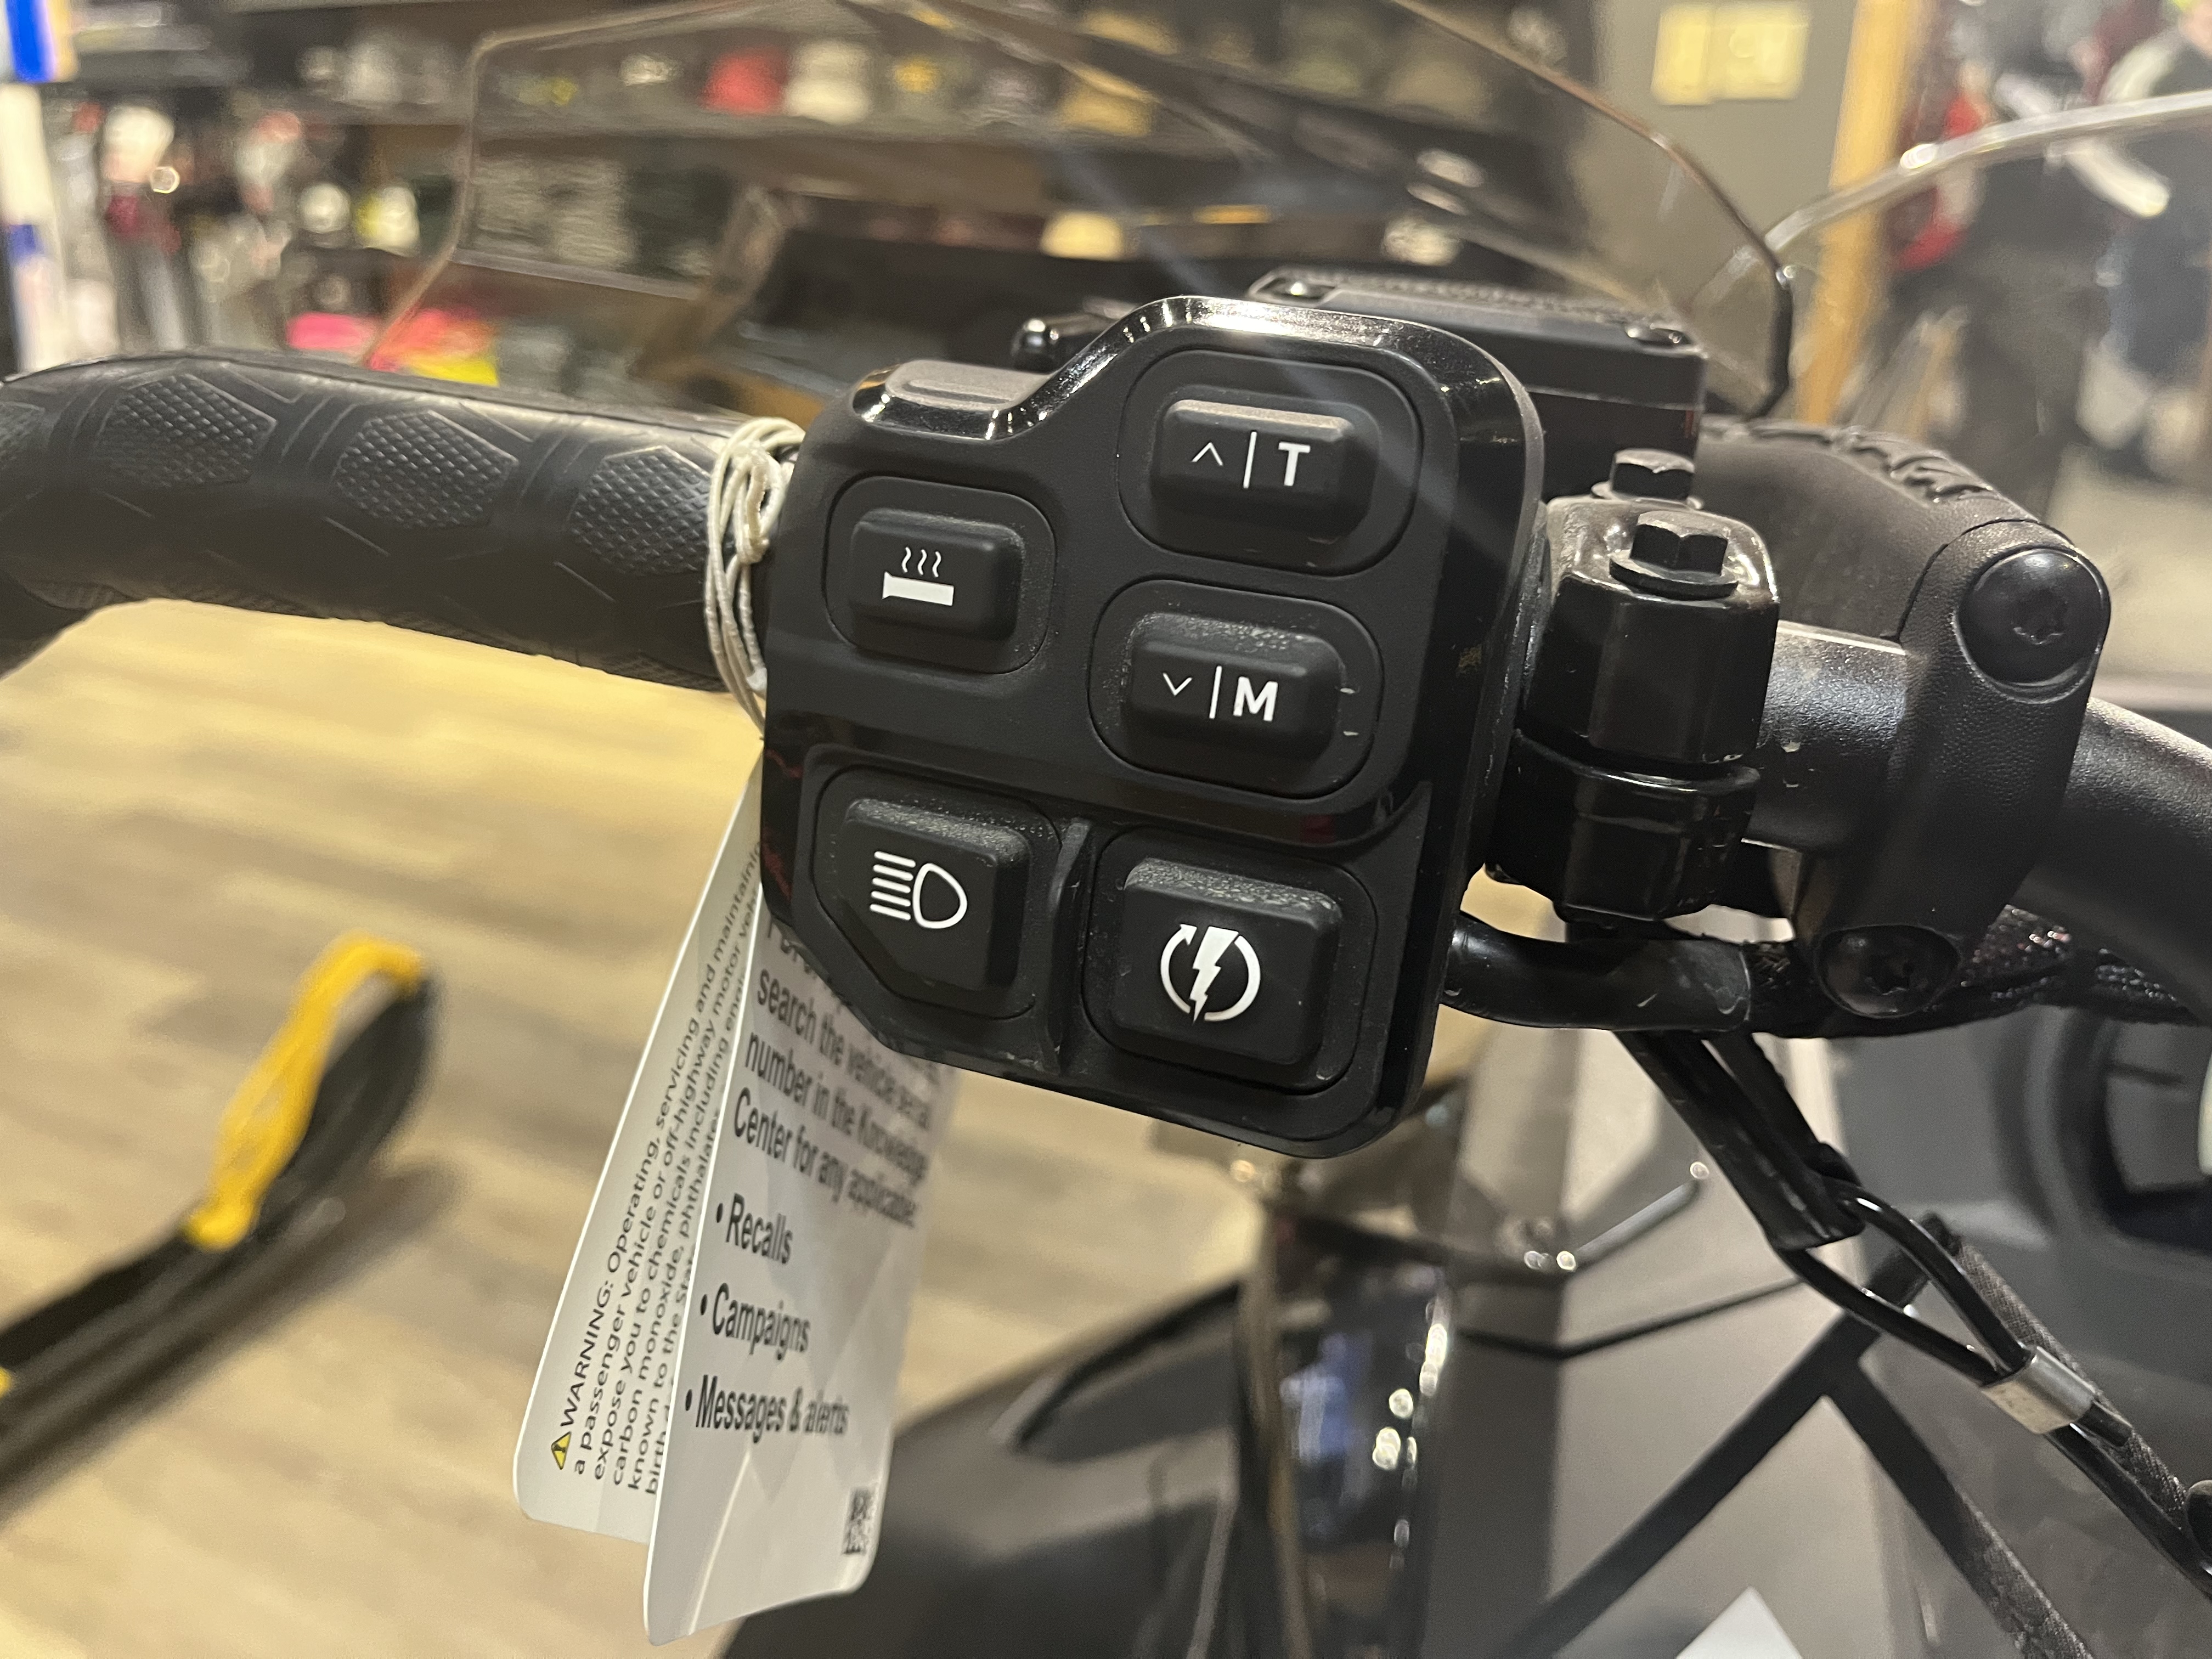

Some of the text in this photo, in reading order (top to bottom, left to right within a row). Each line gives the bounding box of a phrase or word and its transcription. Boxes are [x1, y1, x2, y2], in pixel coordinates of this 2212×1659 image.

[757, 968, 816, 1044] search
[745, 1032, 812, 1106] number
[812, 1073, 830, 1119] in
[735, 1087, 792, 1162] Center
[793, 1125, 819, 1176] for
[560, 1280, 613, 1426] WARNING:
[607, 1138, 660, 1273] Operating,
[656, 1018, 699, 1130] servicing
[696, 964, 715, 1014] and
[574, 1460, 585, 1475] a
[580, 1304, 625, 1450] passenger
[621, 1206, 656, 1297] vehicle
[653, 1170, 665, 1199] or
[664, 1019, 715, 1166] off-highway
[713, 941, 740, 1015] motor
[725, 1192, 793, 1263] Recalls
[595, 1379, 626, 1480] expose
[620, 1322, 641, 1373] you
[636, 1288, 651, 1313] to
[648, 1155, 690, 1280] chemicals
[685, 1037, 729, 1149] including
[613, 1389, 642, 1485] carbon
[639, 1246, 684, 1380] monoxide,
[713, 1282, 811, 1361] Campaigns
[628, 1398, 659, 1489] known
[653, 1363, 667, 1387] to
[663, 1313, 680, 1353] the
[696, 1374, 787, 1443] Messages
[788, 1386, 803, 1432] &
